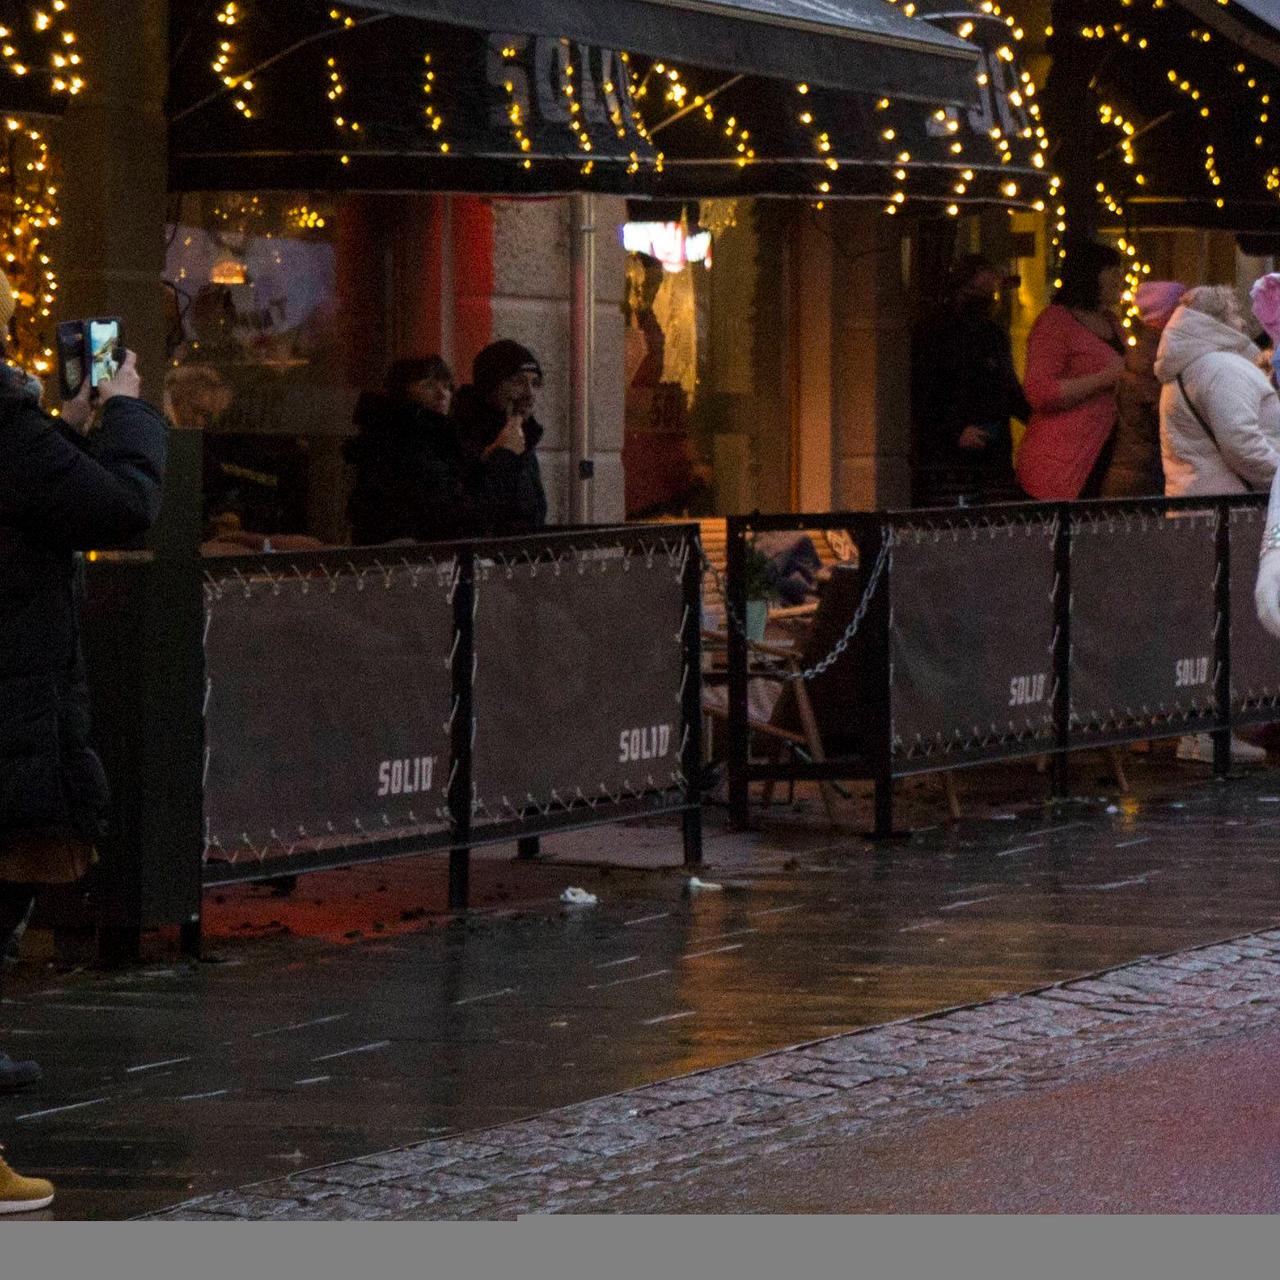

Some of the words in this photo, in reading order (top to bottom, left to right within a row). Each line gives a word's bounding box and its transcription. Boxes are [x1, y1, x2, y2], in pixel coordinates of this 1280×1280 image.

[1008, 673, 1046, 706] SOLID
[1175, 656, 1208, 687] SOLID
[618, 723, 670, 763] SOLID
[377, 755, 433, 796] SOLID
